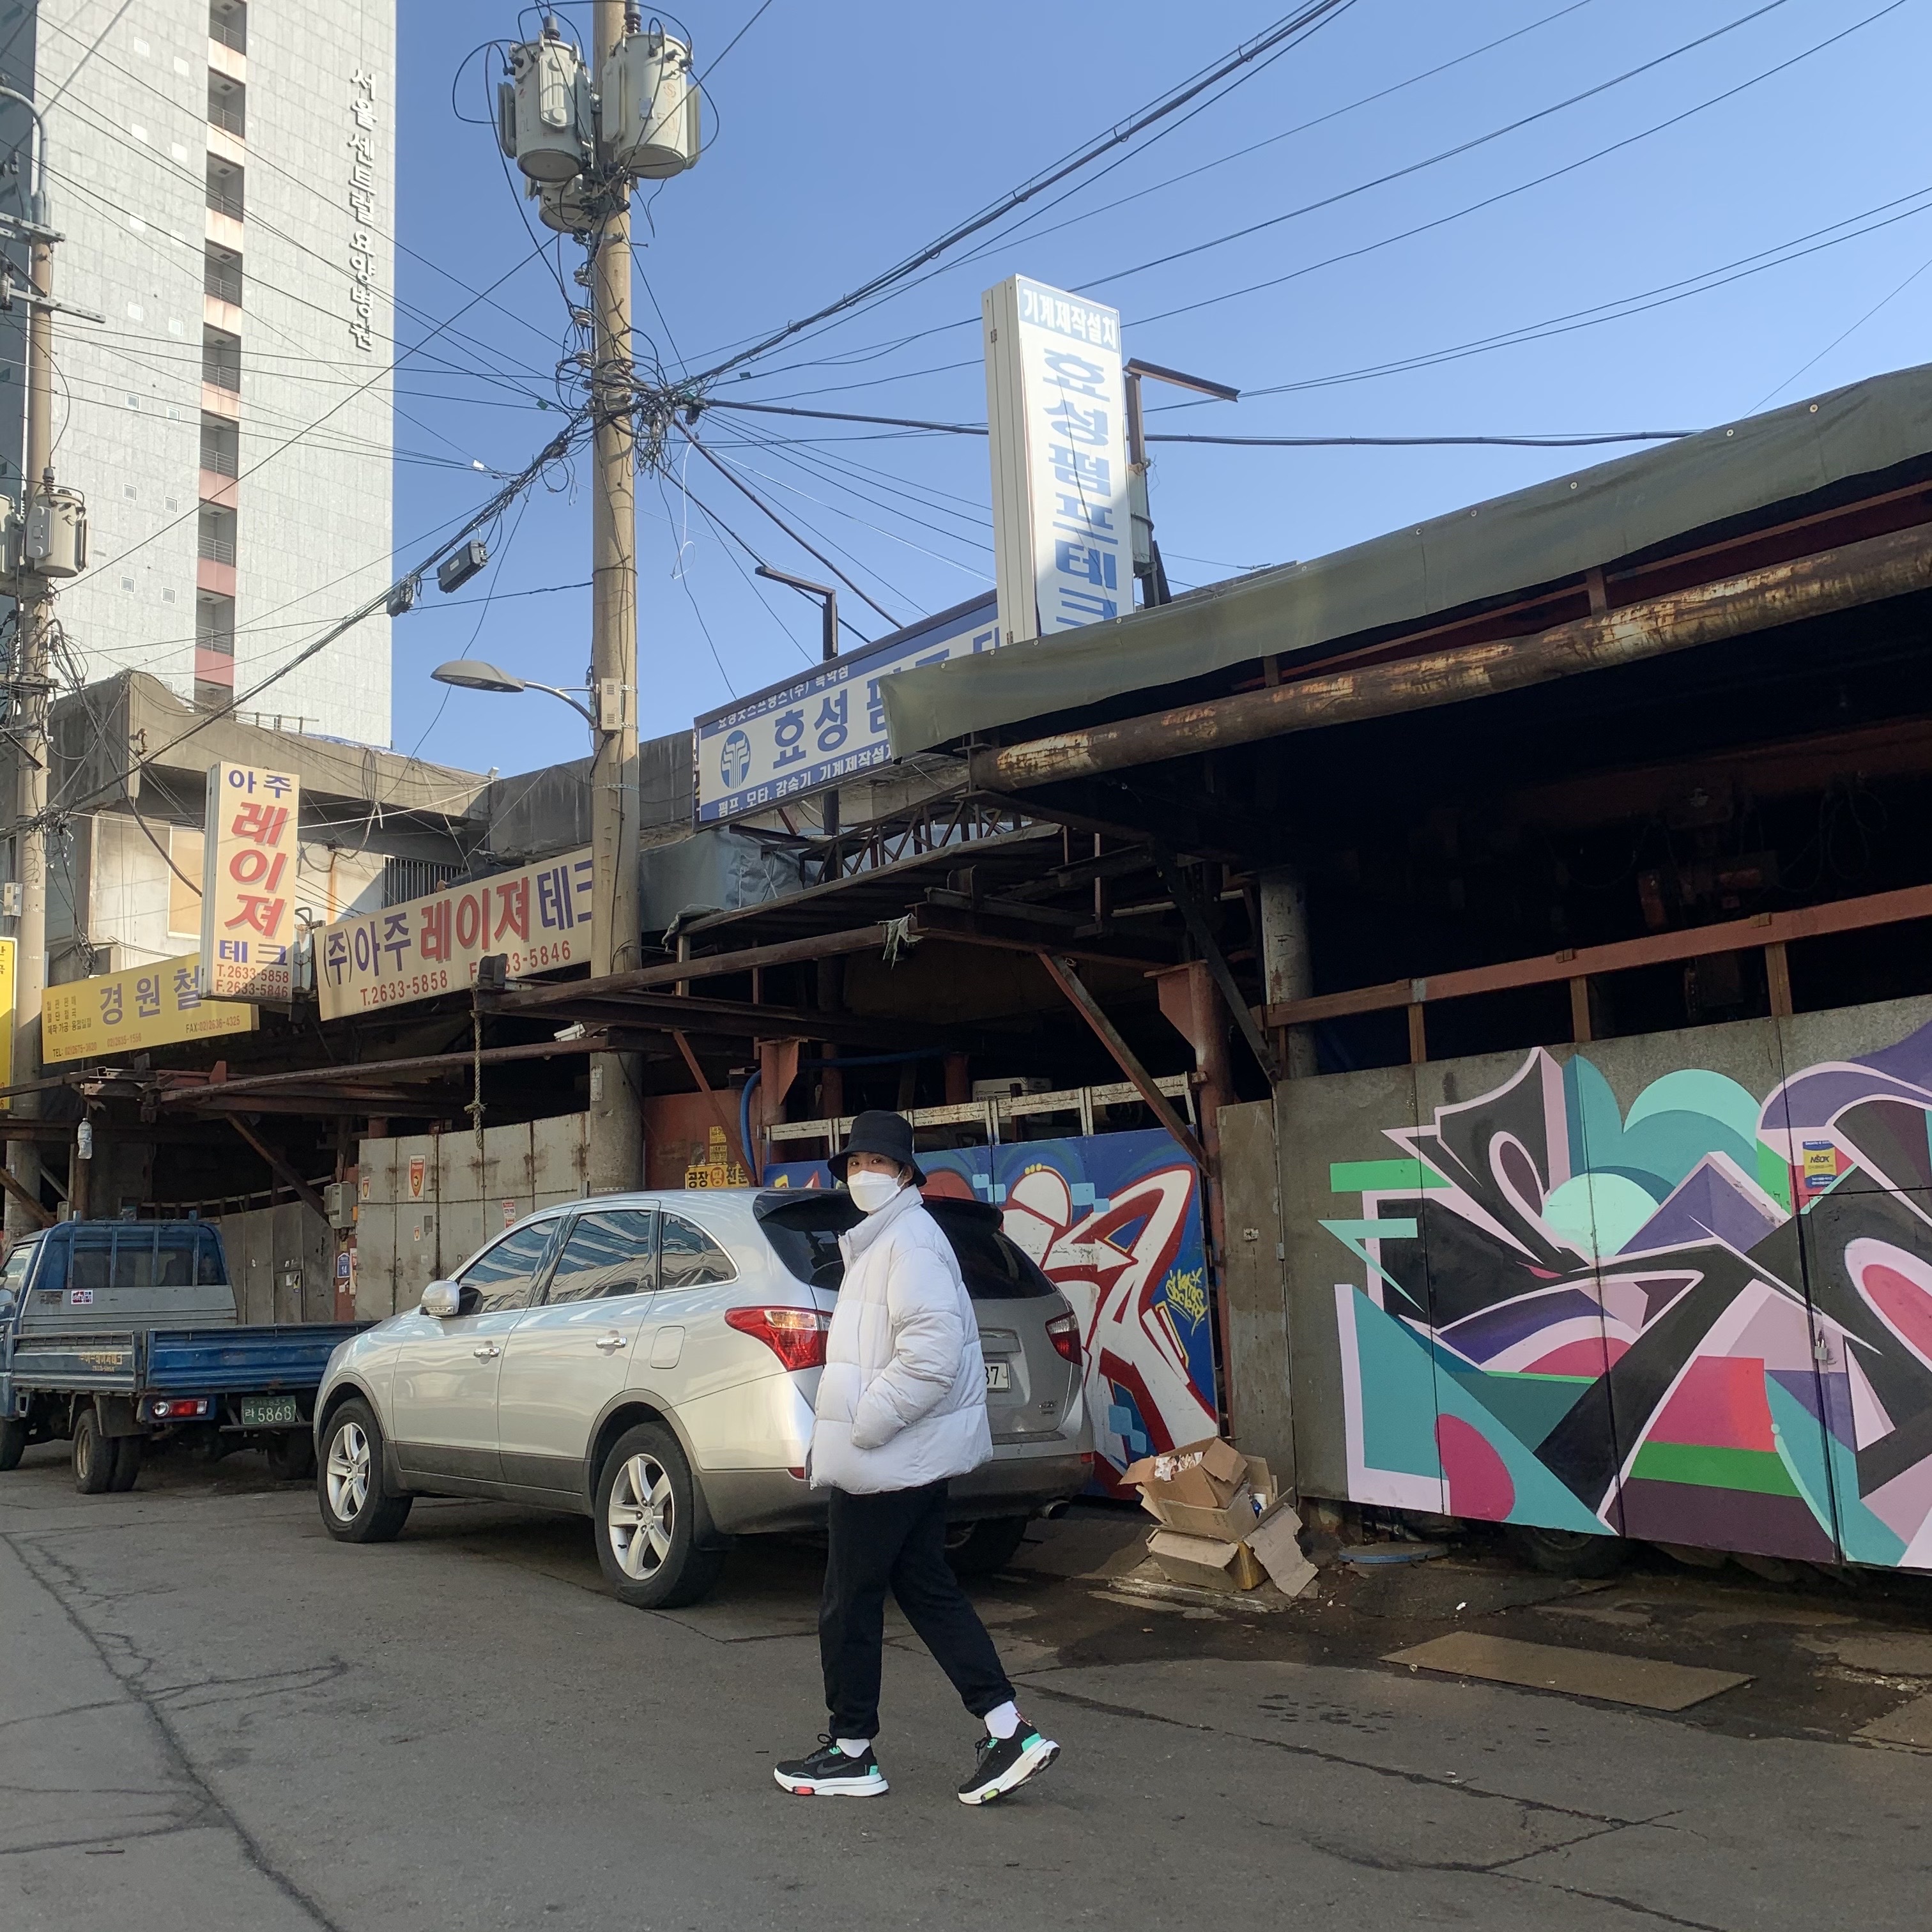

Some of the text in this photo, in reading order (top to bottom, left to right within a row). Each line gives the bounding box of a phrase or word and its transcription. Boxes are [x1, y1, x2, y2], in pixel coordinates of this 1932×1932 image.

[1023, 289, 1116, 349] 기계제작설치
[227, 769, 291, 799] 아주
[224, 802, 290, 937] 레이져
[218, 940, 288, 966] 테크
[217, 963, 289, 983] T.2633-5858
[360, 969, 448, 1006] T.2633-5858
[215, 979, 288, 998] F.2633-5846
